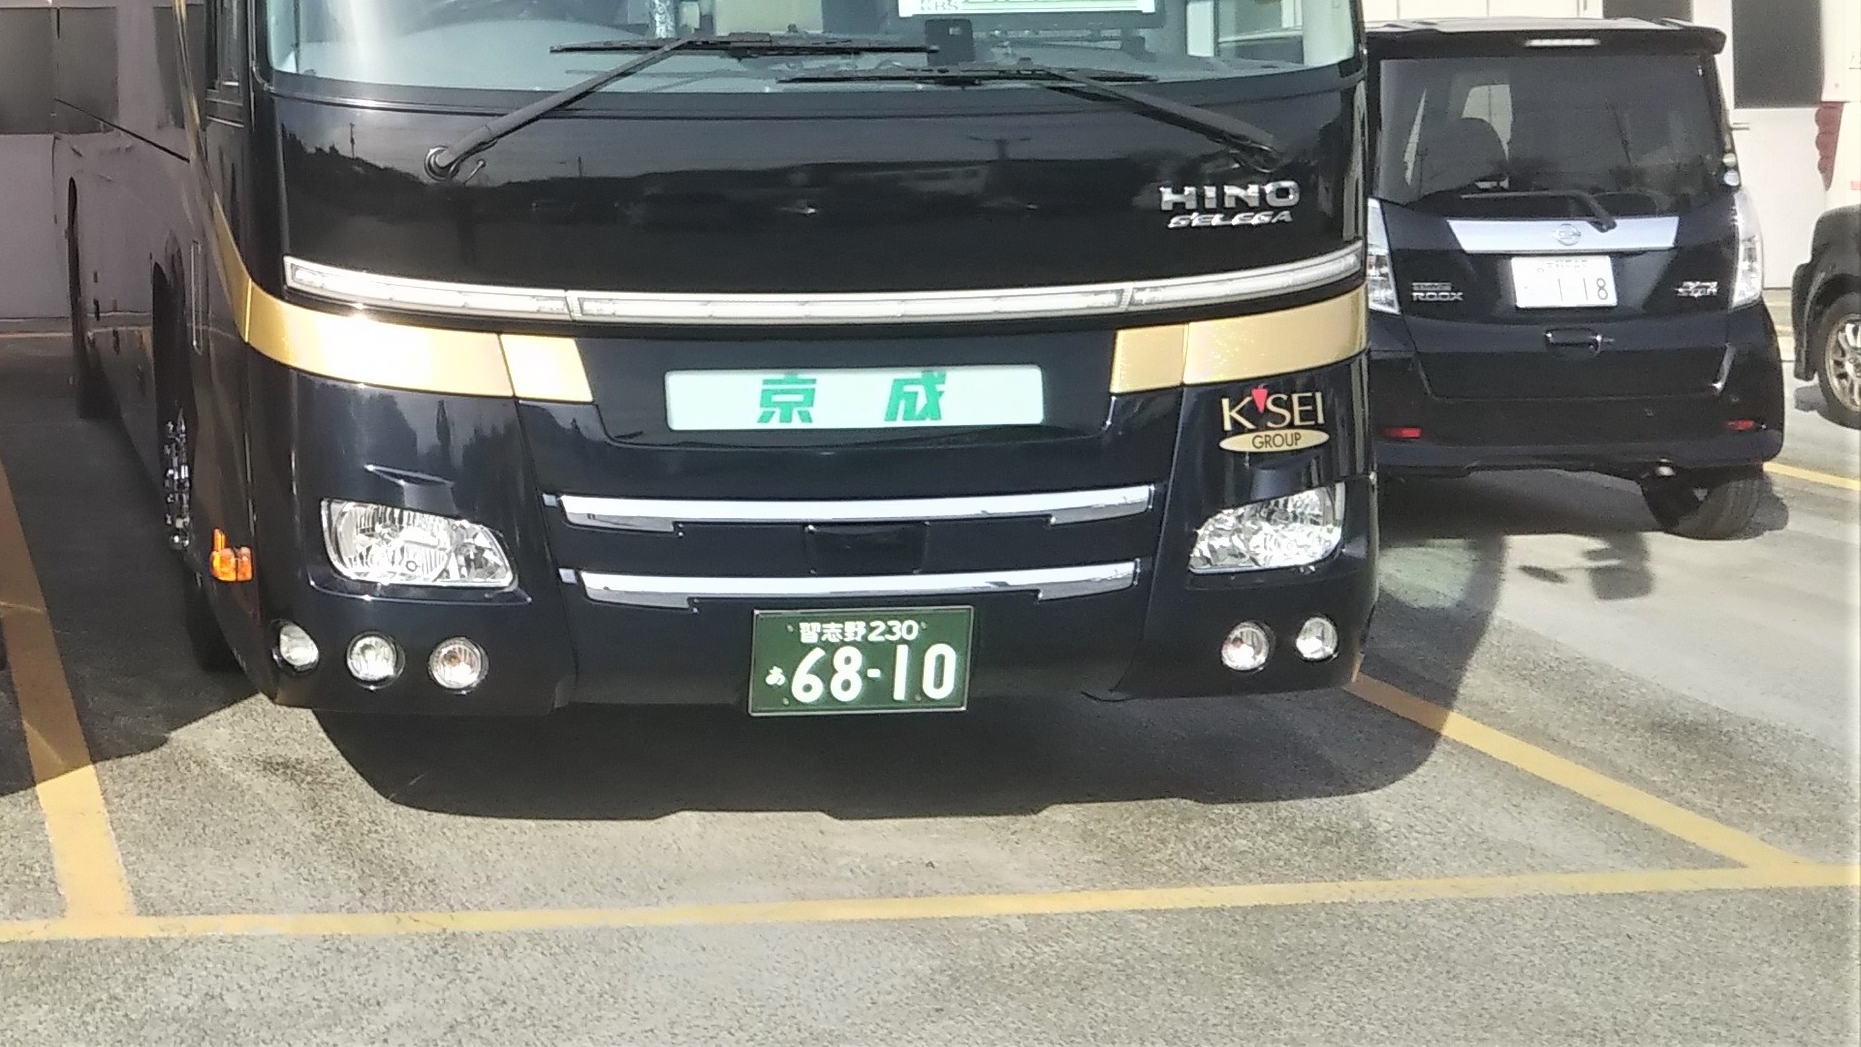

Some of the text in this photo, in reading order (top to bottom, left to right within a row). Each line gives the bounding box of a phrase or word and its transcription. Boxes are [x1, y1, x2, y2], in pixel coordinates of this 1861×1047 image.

[1159, 180, 1301, 211] HINO
[1411, 291, 1464, 302] ROOX
[756, 370, 948, 424] 京成
[1251, 432, 1302, 449] GROUP
[765, 643, 957, 704] あ 68-10
